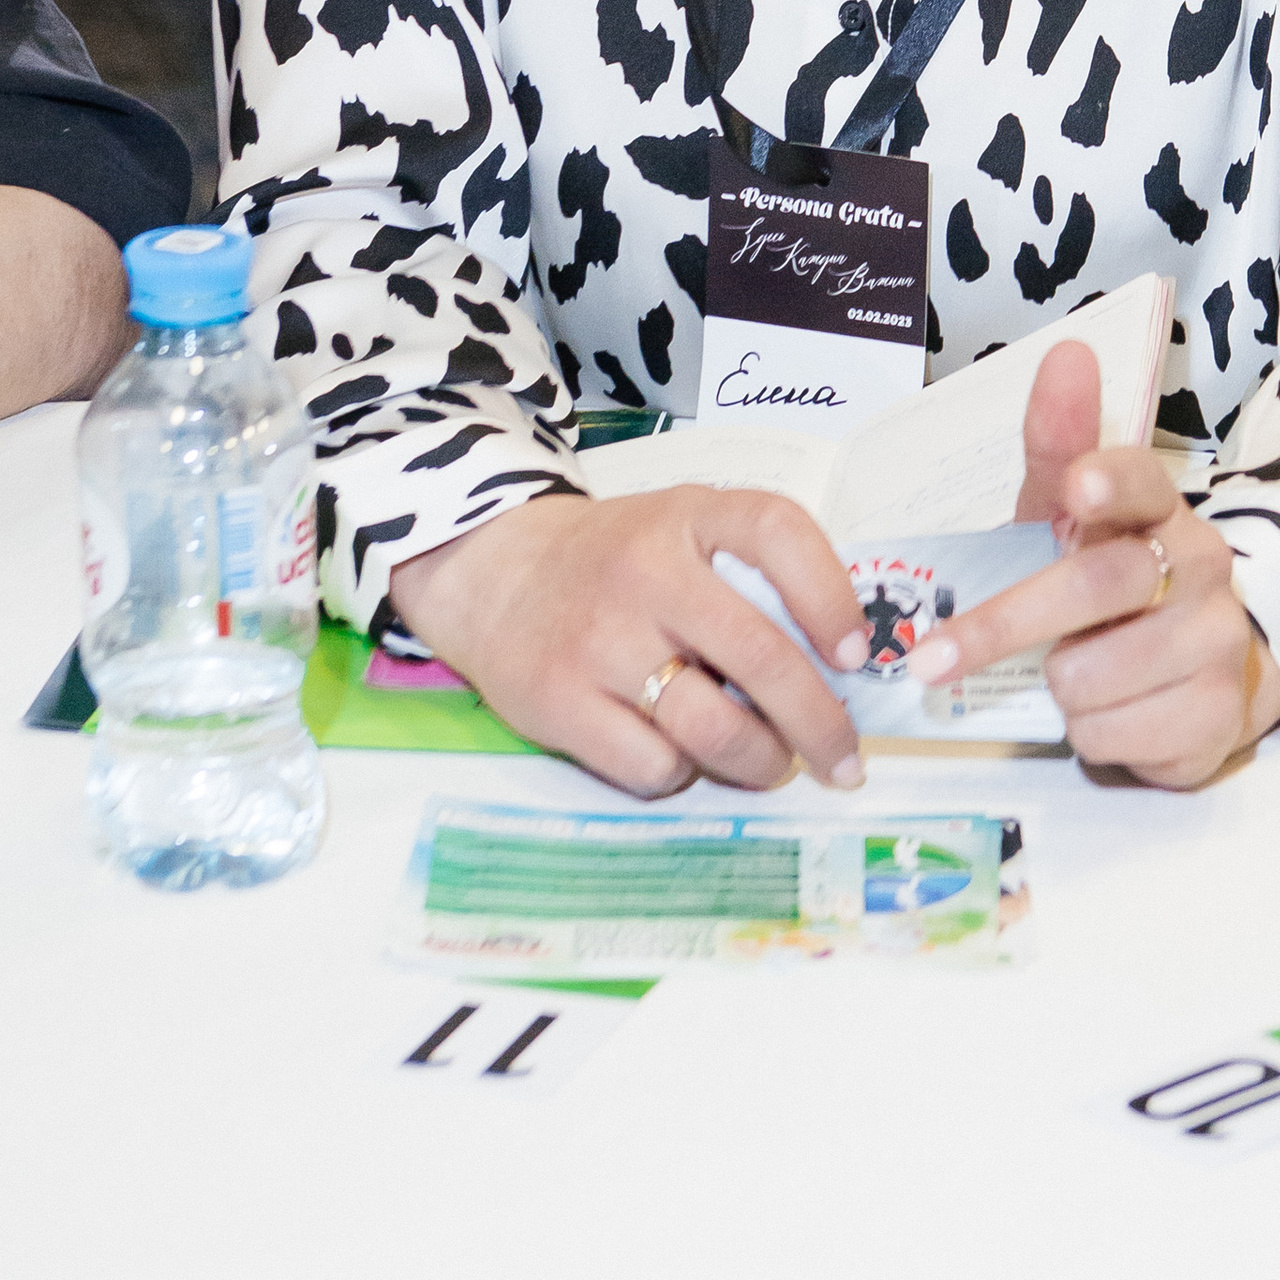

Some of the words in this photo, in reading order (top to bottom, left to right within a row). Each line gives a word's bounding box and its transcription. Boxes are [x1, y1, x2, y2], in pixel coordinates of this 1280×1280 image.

[740, 186, 833, 219] Persona
[838, 201, 906, 230] Grata
[716, 352, 847, 407] Елена
